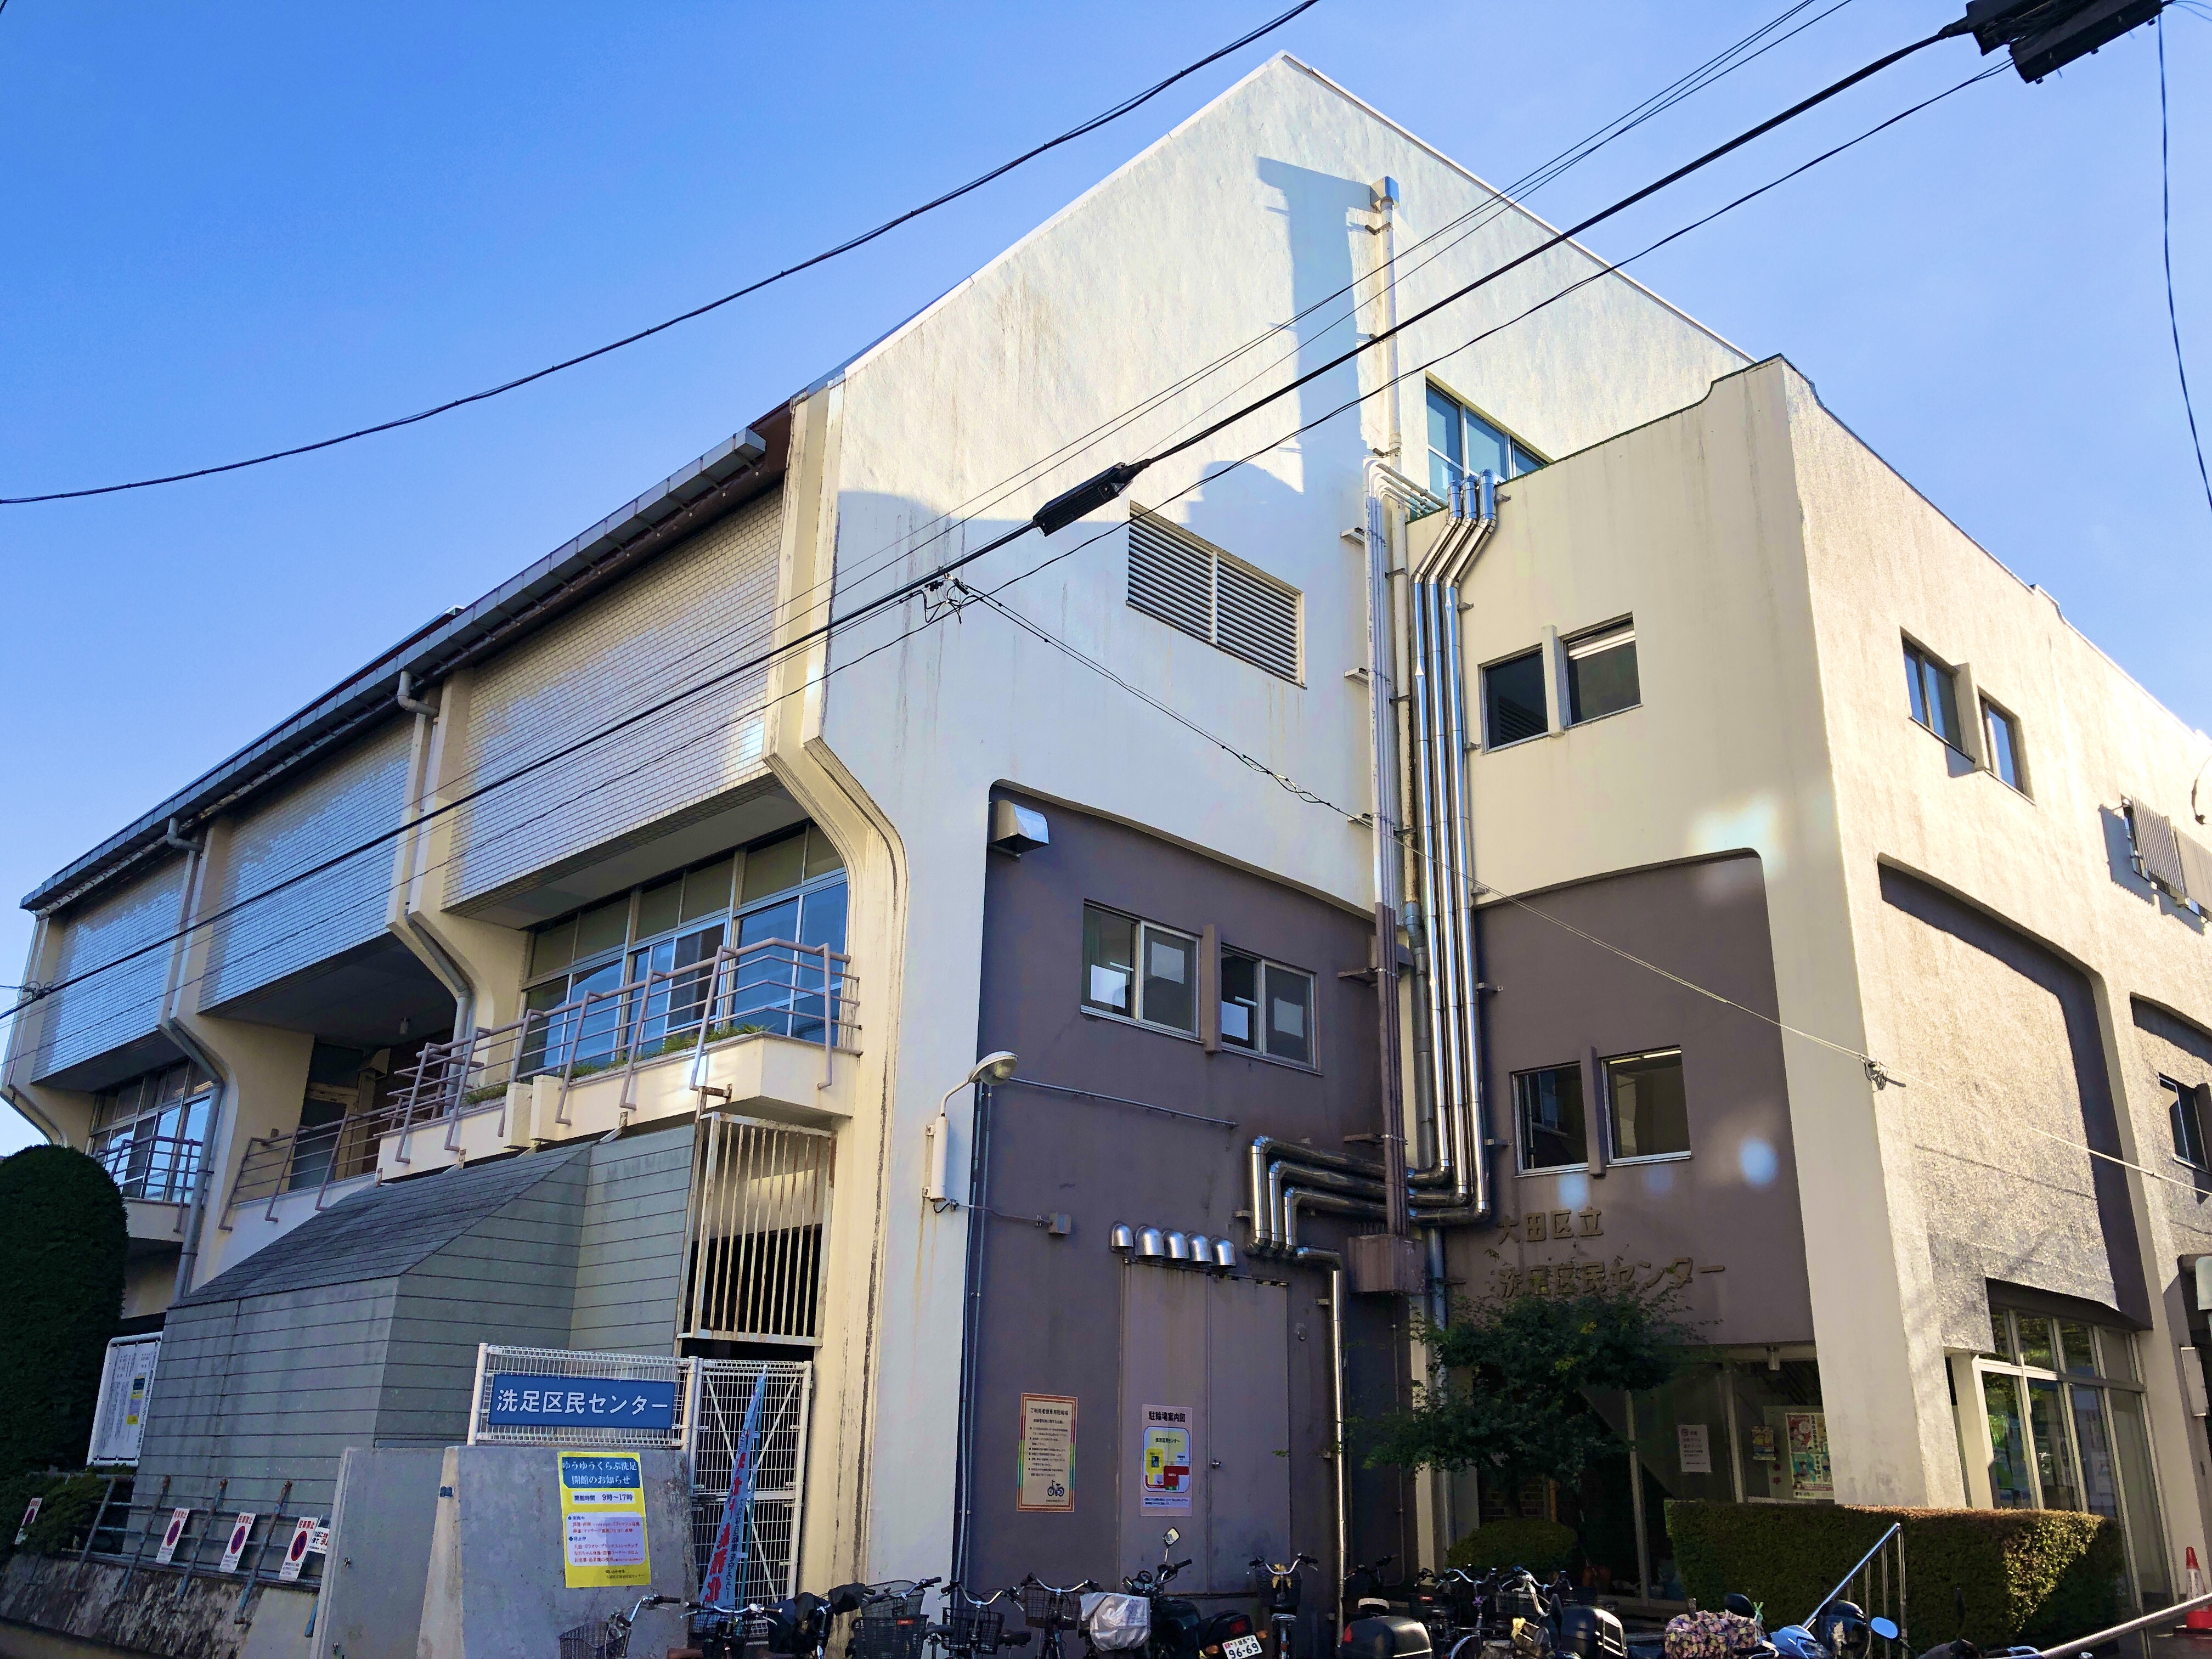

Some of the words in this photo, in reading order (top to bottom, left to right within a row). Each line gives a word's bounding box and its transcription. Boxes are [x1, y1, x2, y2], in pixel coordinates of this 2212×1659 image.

[1497, 1206, 1604, 1245] 大田区立
[495, 1389, 669, 1415] 洗足区民センター
[1148, 1410, 1186, 1423] 駐輪場案内図
[562, 1460, 638, 1471] ゆうゆうくらぶ洗足
[571, 1475, 631, 1485] 開館のお知らせ
